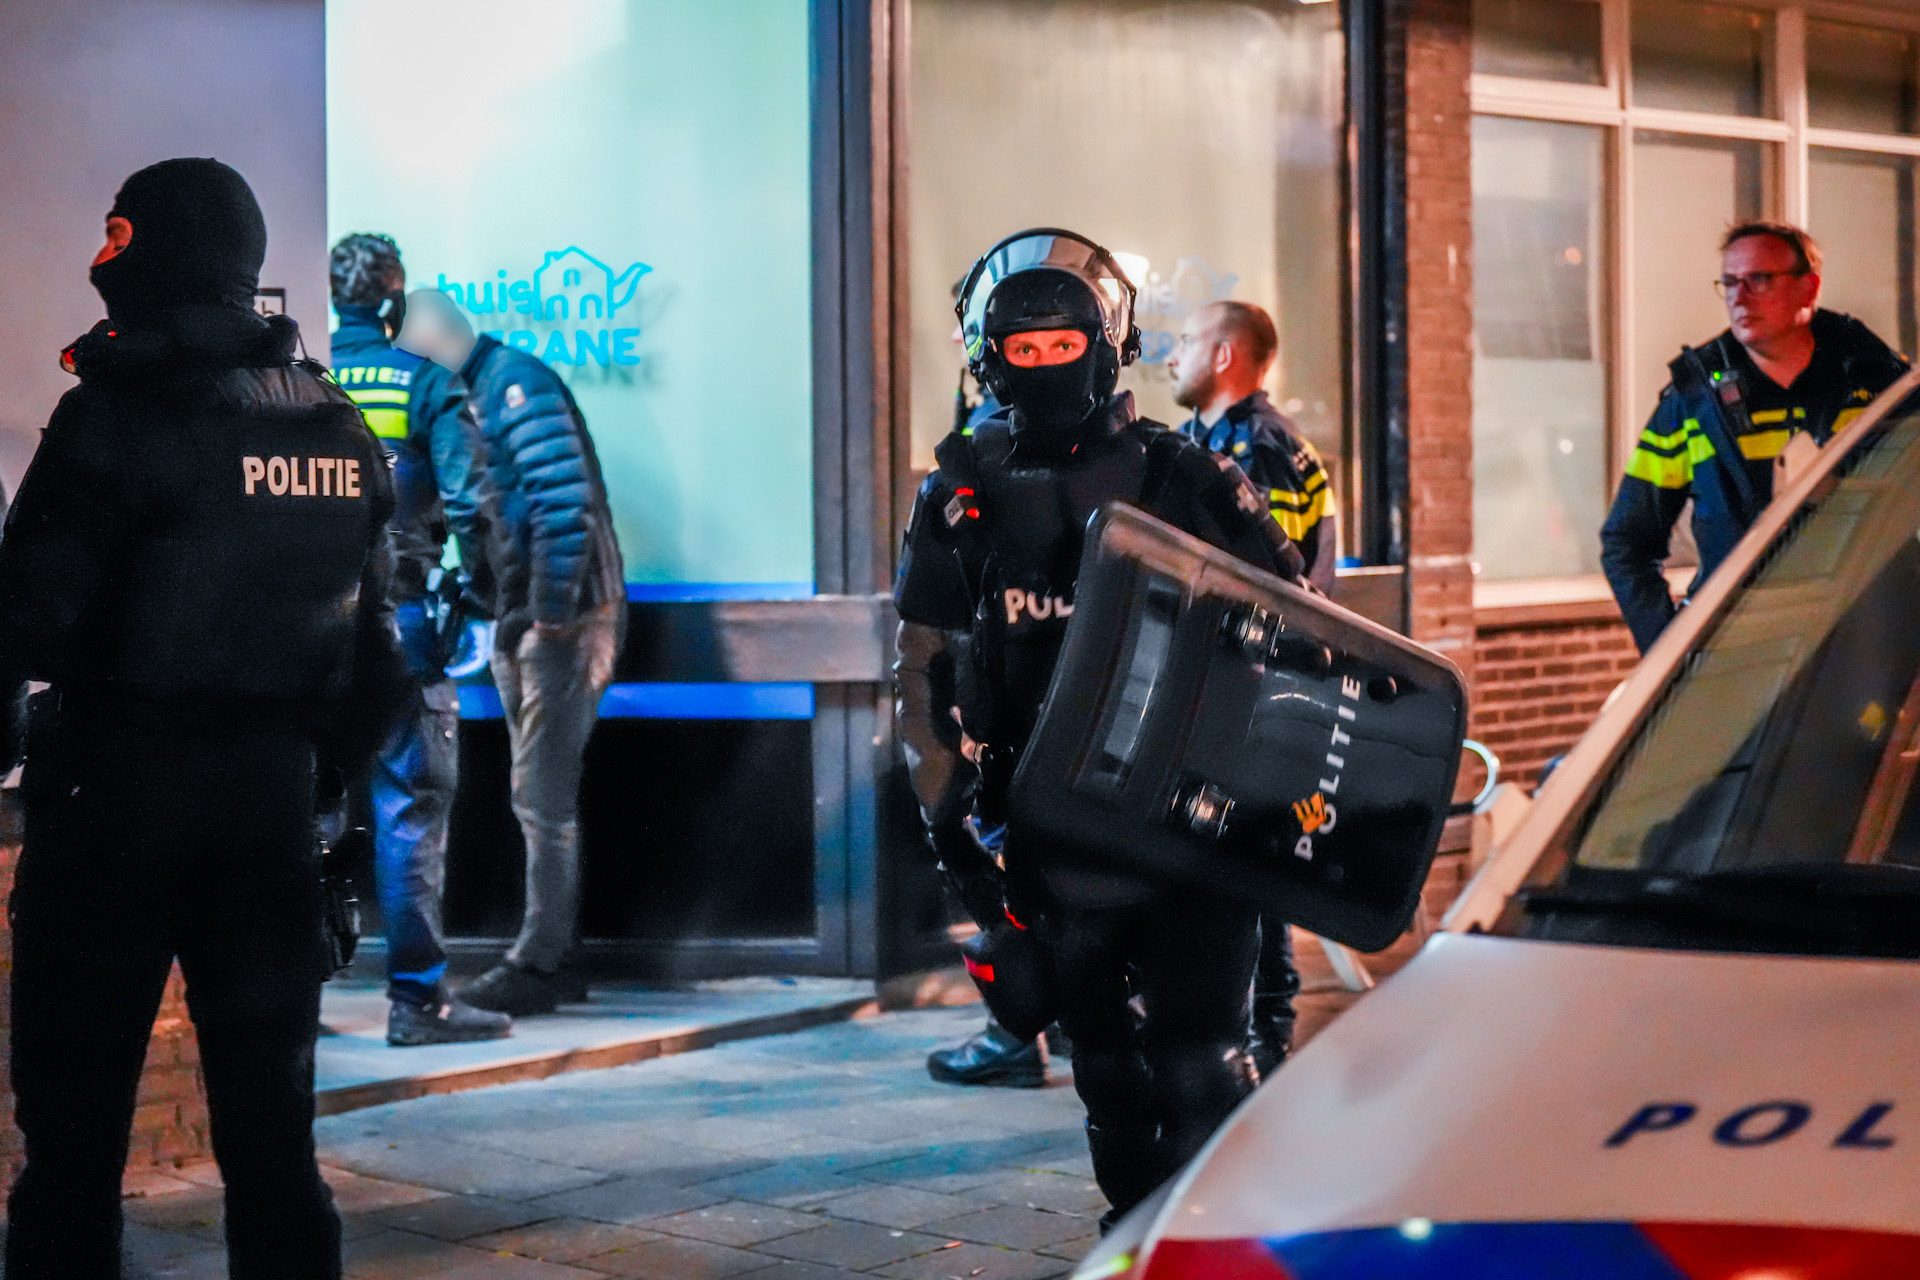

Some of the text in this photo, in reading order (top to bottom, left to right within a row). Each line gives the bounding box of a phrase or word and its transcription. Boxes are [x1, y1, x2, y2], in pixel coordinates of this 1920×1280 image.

[243, 456, 361, 497] POLITIE
[1294, 674, 1361, 861] POLITIE
[1604, 1101, 1896, 1149] POL
